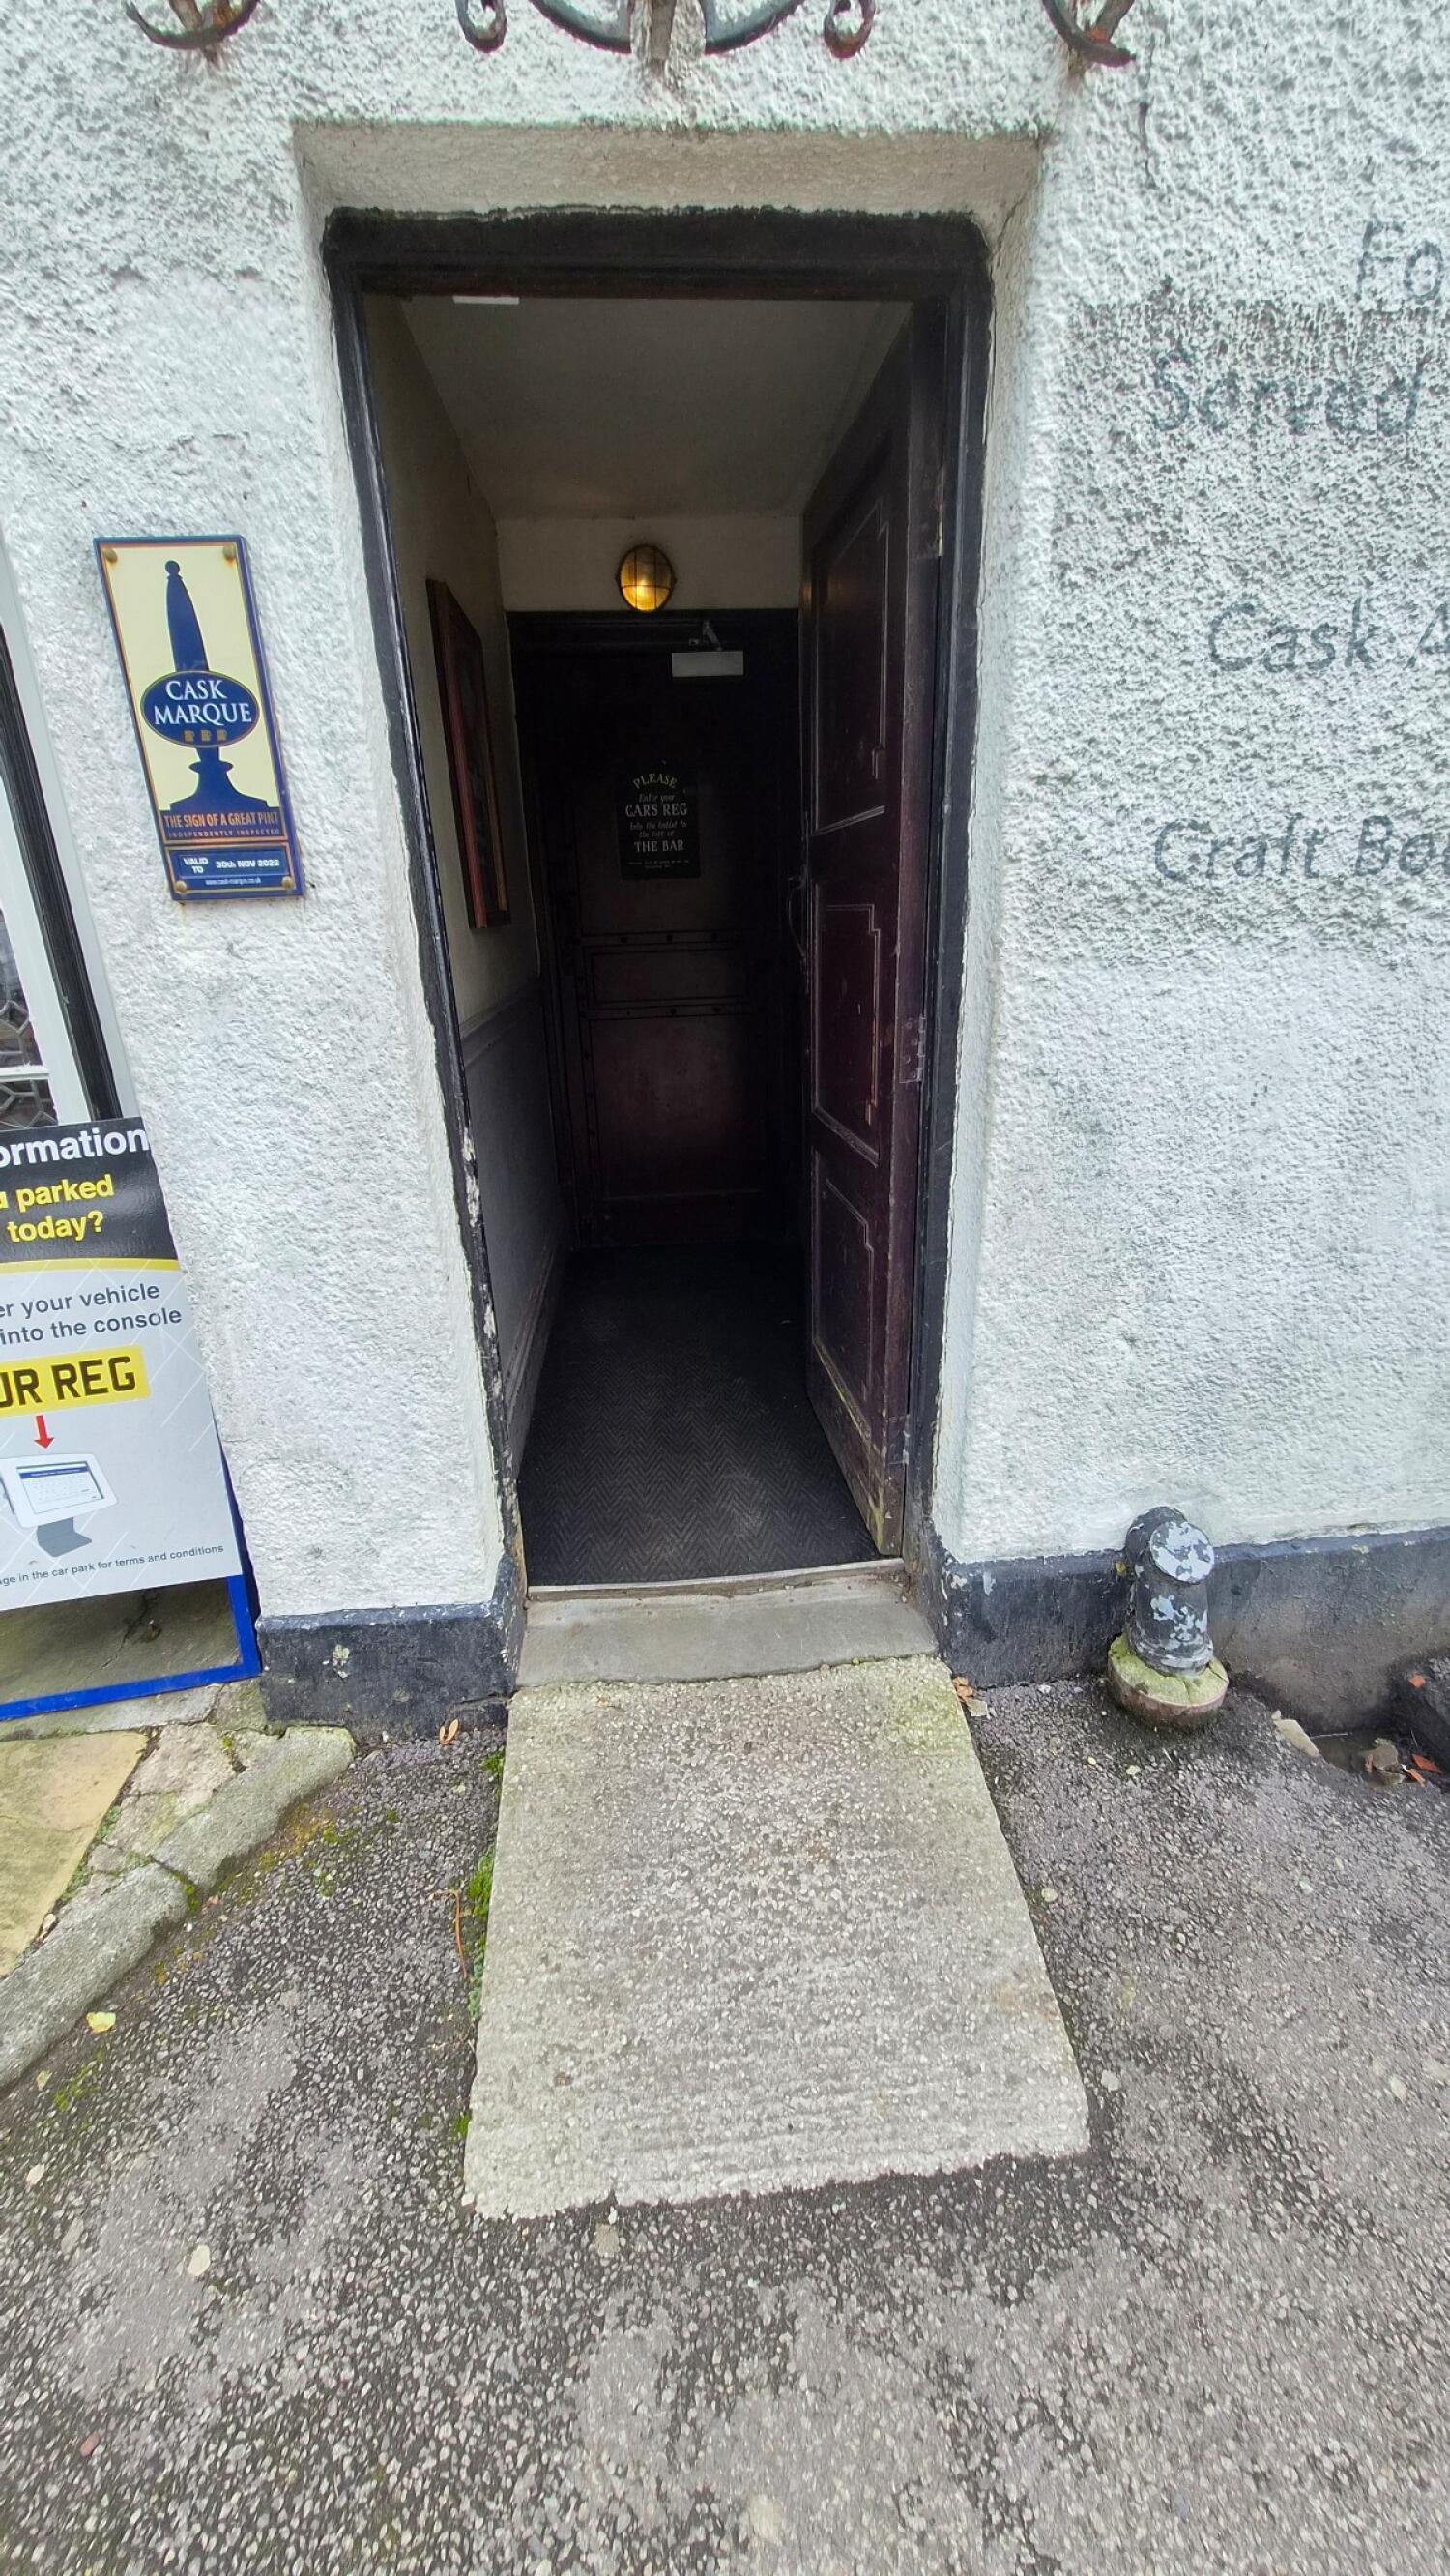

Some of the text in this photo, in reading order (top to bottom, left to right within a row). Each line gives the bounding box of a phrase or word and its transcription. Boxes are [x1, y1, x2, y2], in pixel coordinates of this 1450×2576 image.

[1208, 597, 1378, 673] Cask
[165, 680, 227, 700] CASK
[155, 703, 252, 726] MARQUE
[633, 773, 679, 789] PLEASE
[660, 795, 676, 804] your
[163, 811, 278, 829] THE SIGN OF A GREAT PINT
[625, 803, 688, 817] CARS REG
[169, 830, 232, 838] INDEPENDENTLY
[634, 840, 685, 852] THE BAR
[1155, 813, 1450, 880] Craft Be
[183, 857, 209, 865] VALID
[191, 865, 204, 874] TO
[216, 861, 237, 869] 30th
[237, 860, 256, 868] NOV
[15, 1174, 115, 1213] parked
[7, 1210, 103, 1242] today?
[21, 1296, 72, 1319] your
[79, 1283, 160, 1307] vehicle
[0, 1308, 182, 1345] into the console
[50, 1356, 136, 1401] REG
[19, 1573, 29, 1582] in
[32, 1570, 49, 1580] the
[51, 1567, 68, 1577] car
[72, 1563, 95, 1575] park
[98, 1561, 112, 1569] for
[115, 1556, 145, 1567] terms
[148, 1552, 167, 1563] and
[169, 1545, 224, 1559] conditions
